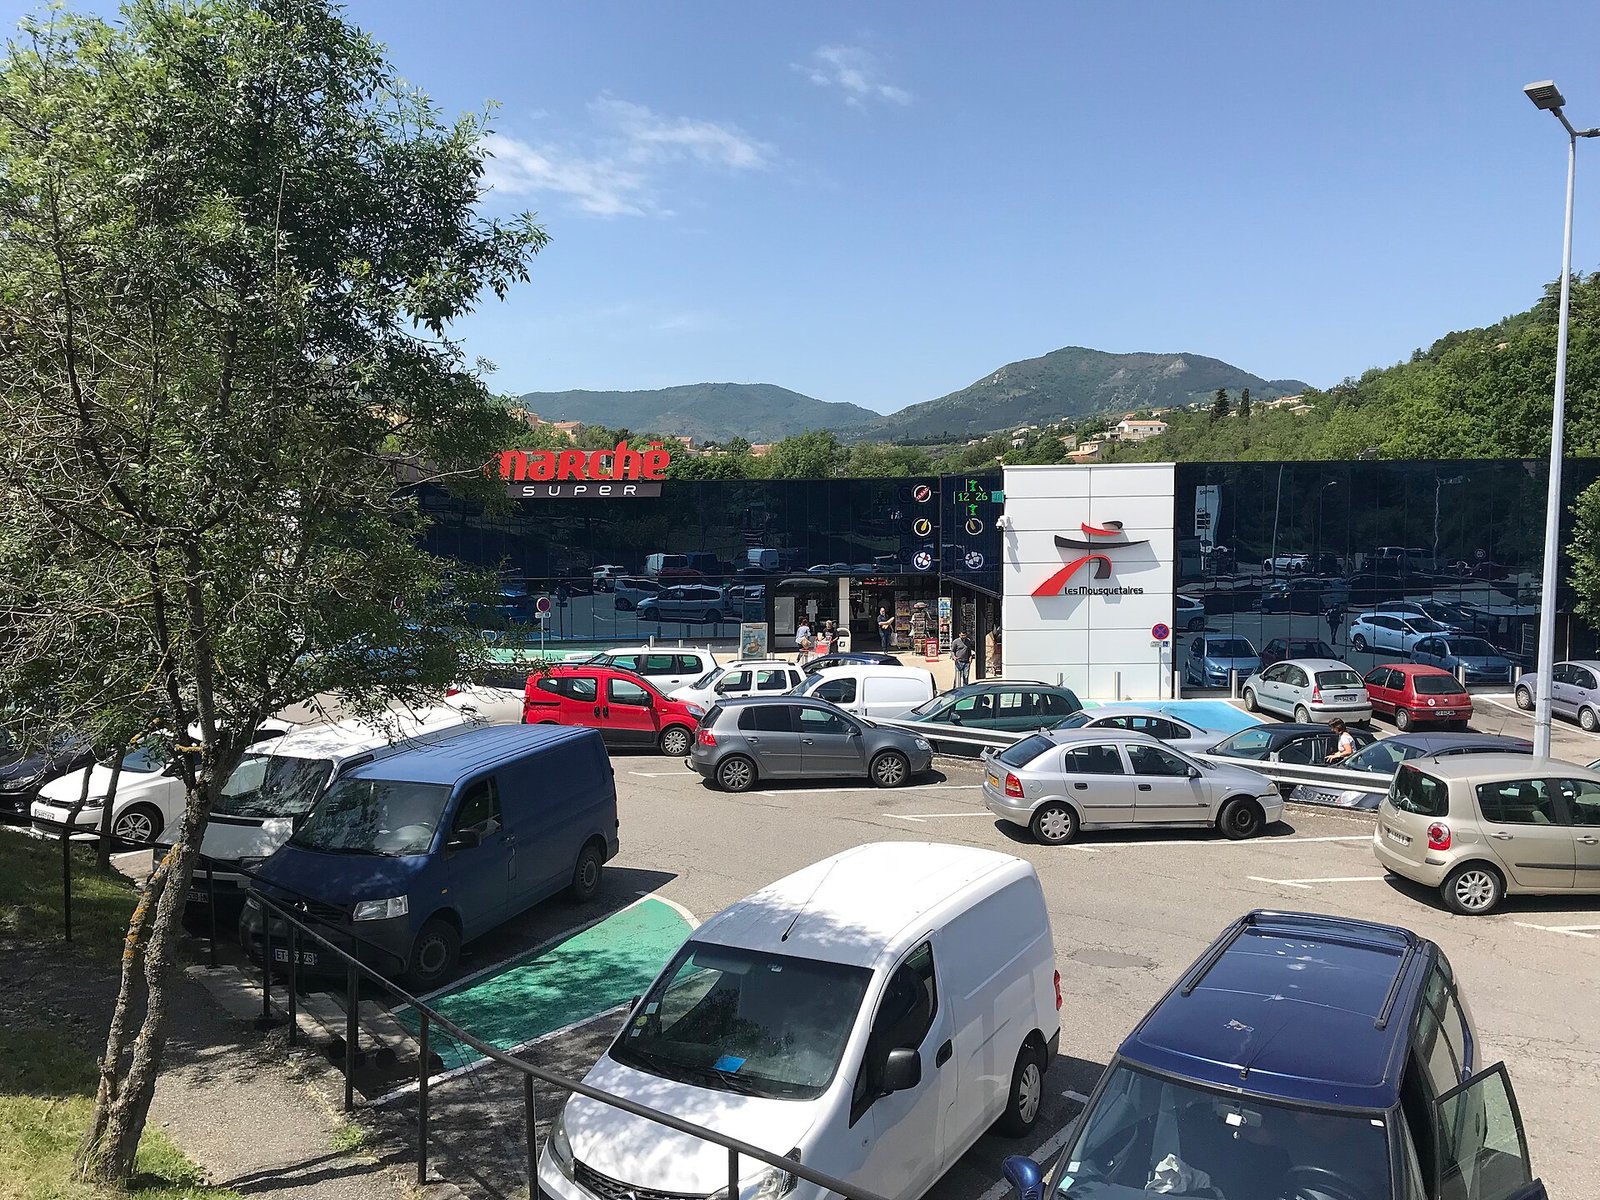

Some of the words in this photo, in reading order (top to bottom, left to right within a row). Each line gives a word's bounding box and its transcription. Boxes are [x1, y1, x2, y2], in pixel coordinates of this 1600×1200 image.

[522, 485, 637, 497] SUPER
[958, 492, 970, 502] 12
[975, 492, 988, 501] 26
